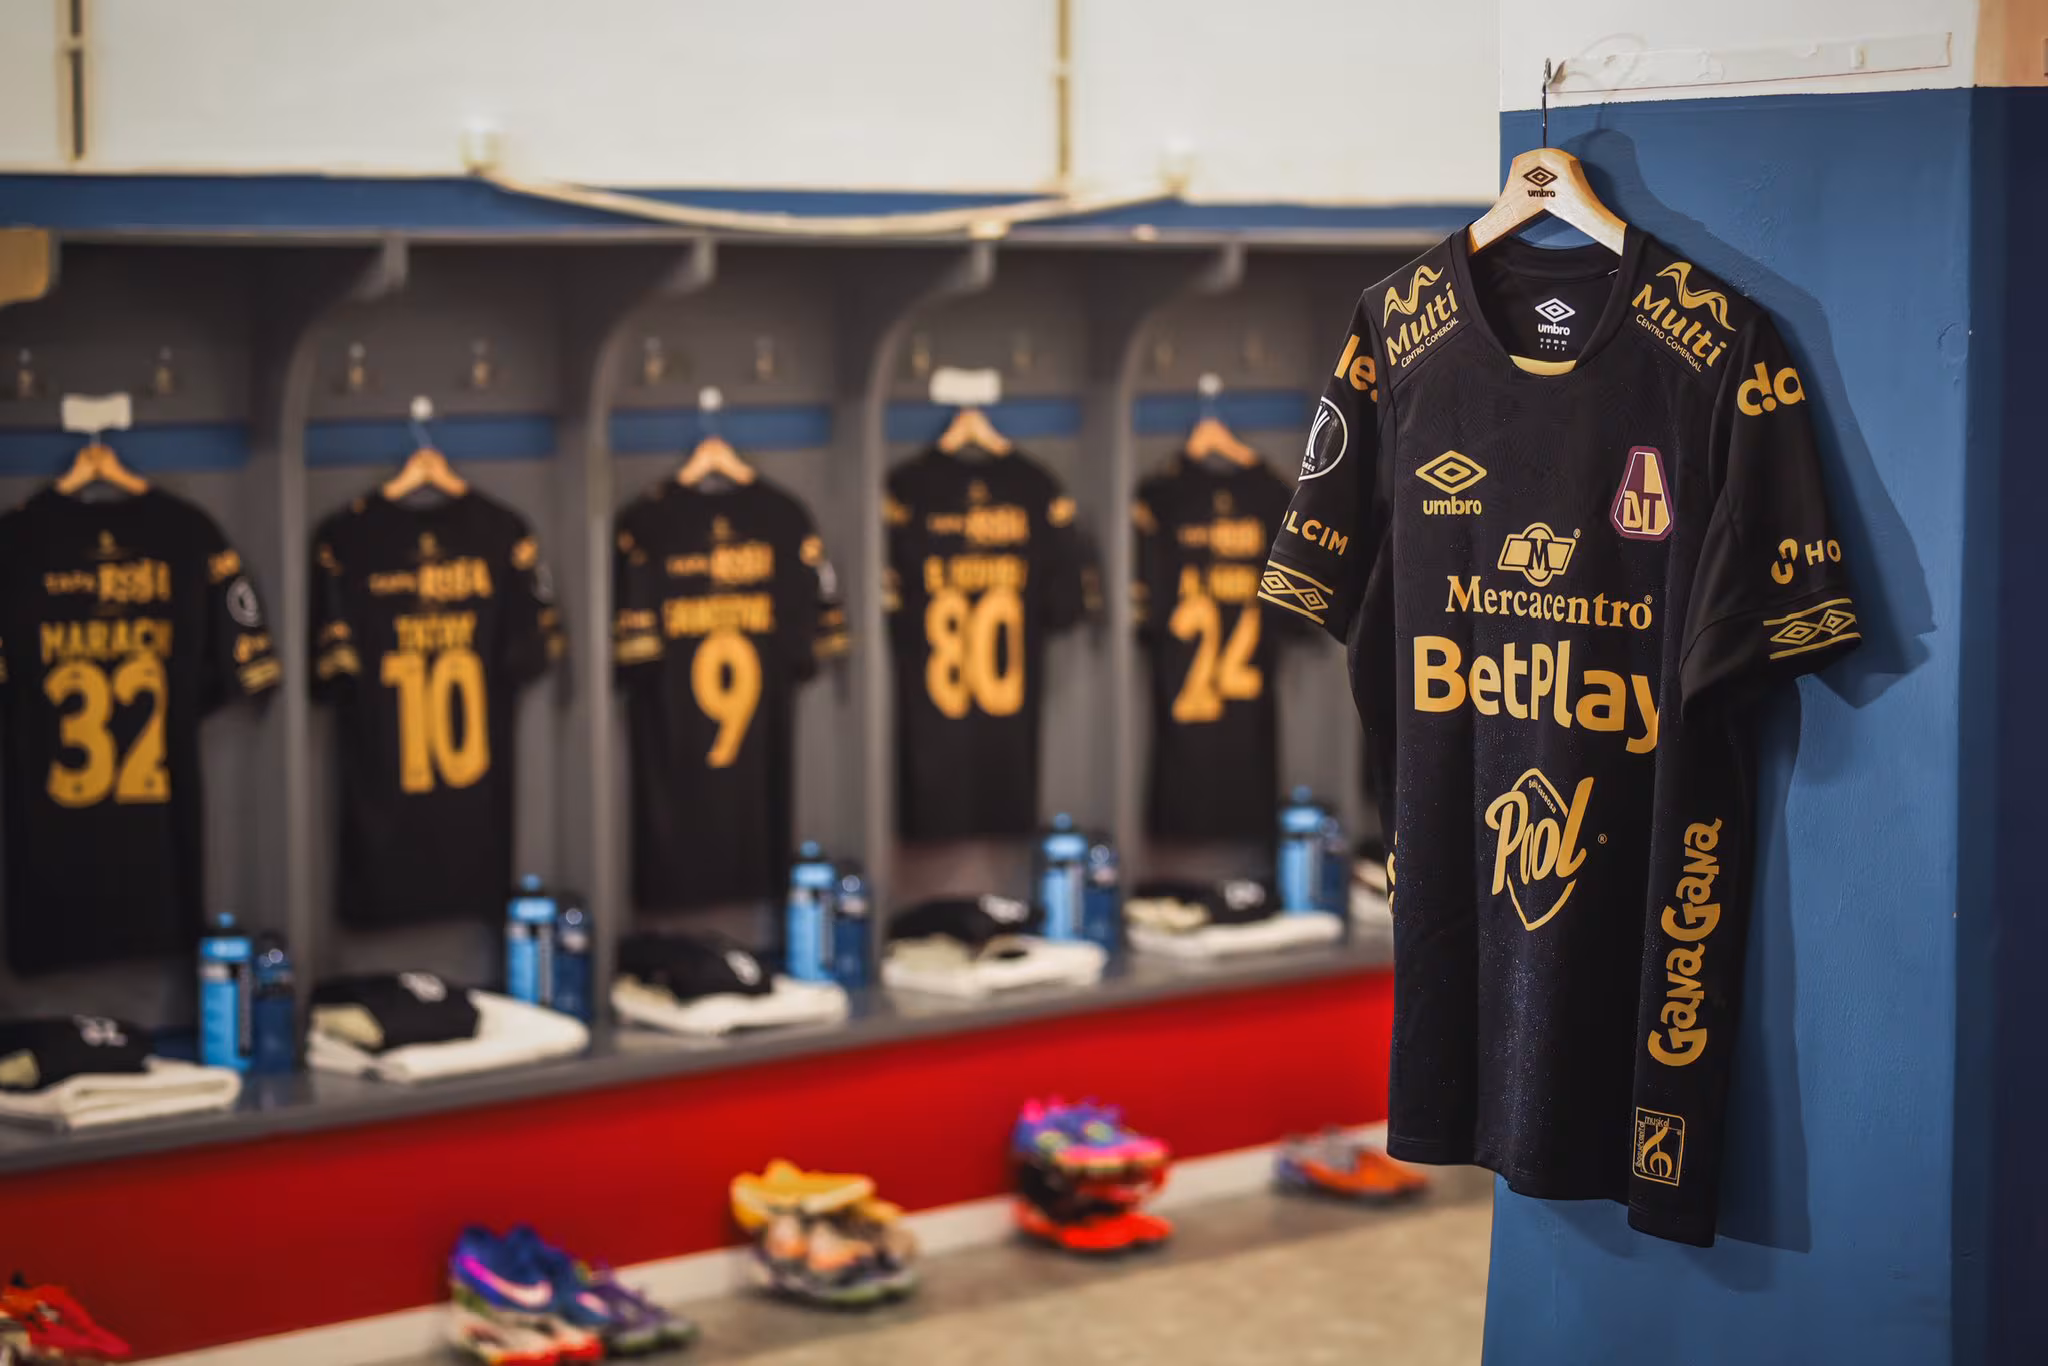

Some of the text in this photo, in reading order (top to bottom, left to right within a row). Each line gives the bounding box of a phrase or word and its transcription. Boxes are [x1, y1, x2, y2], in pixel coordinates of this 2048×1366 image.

[1527, 188, 1556, 198] umbro
[1386, 282, 1459, 366] Multi
[1401, 317, 1459, 368] CENTRO COMERCIAL
[1537, 322, 1571, 336] umbro
[1631, 283, 1728, 367] Multi
[1636, 314, 1702, 372] CENTRO COMERCIAL
[1282, 510, 1349, 556] LCIM
[1422, 496, 1482, 515] umbro
[924, 587, 1025, 719] 80
[1413, 635, 1660, 754] BetPlay
[44, 653, 170, 807] 32
[381, 650, 490, 793] 10
[691, 633, 762, 767] 9
[1485, 776, 1595, 896] Pool
